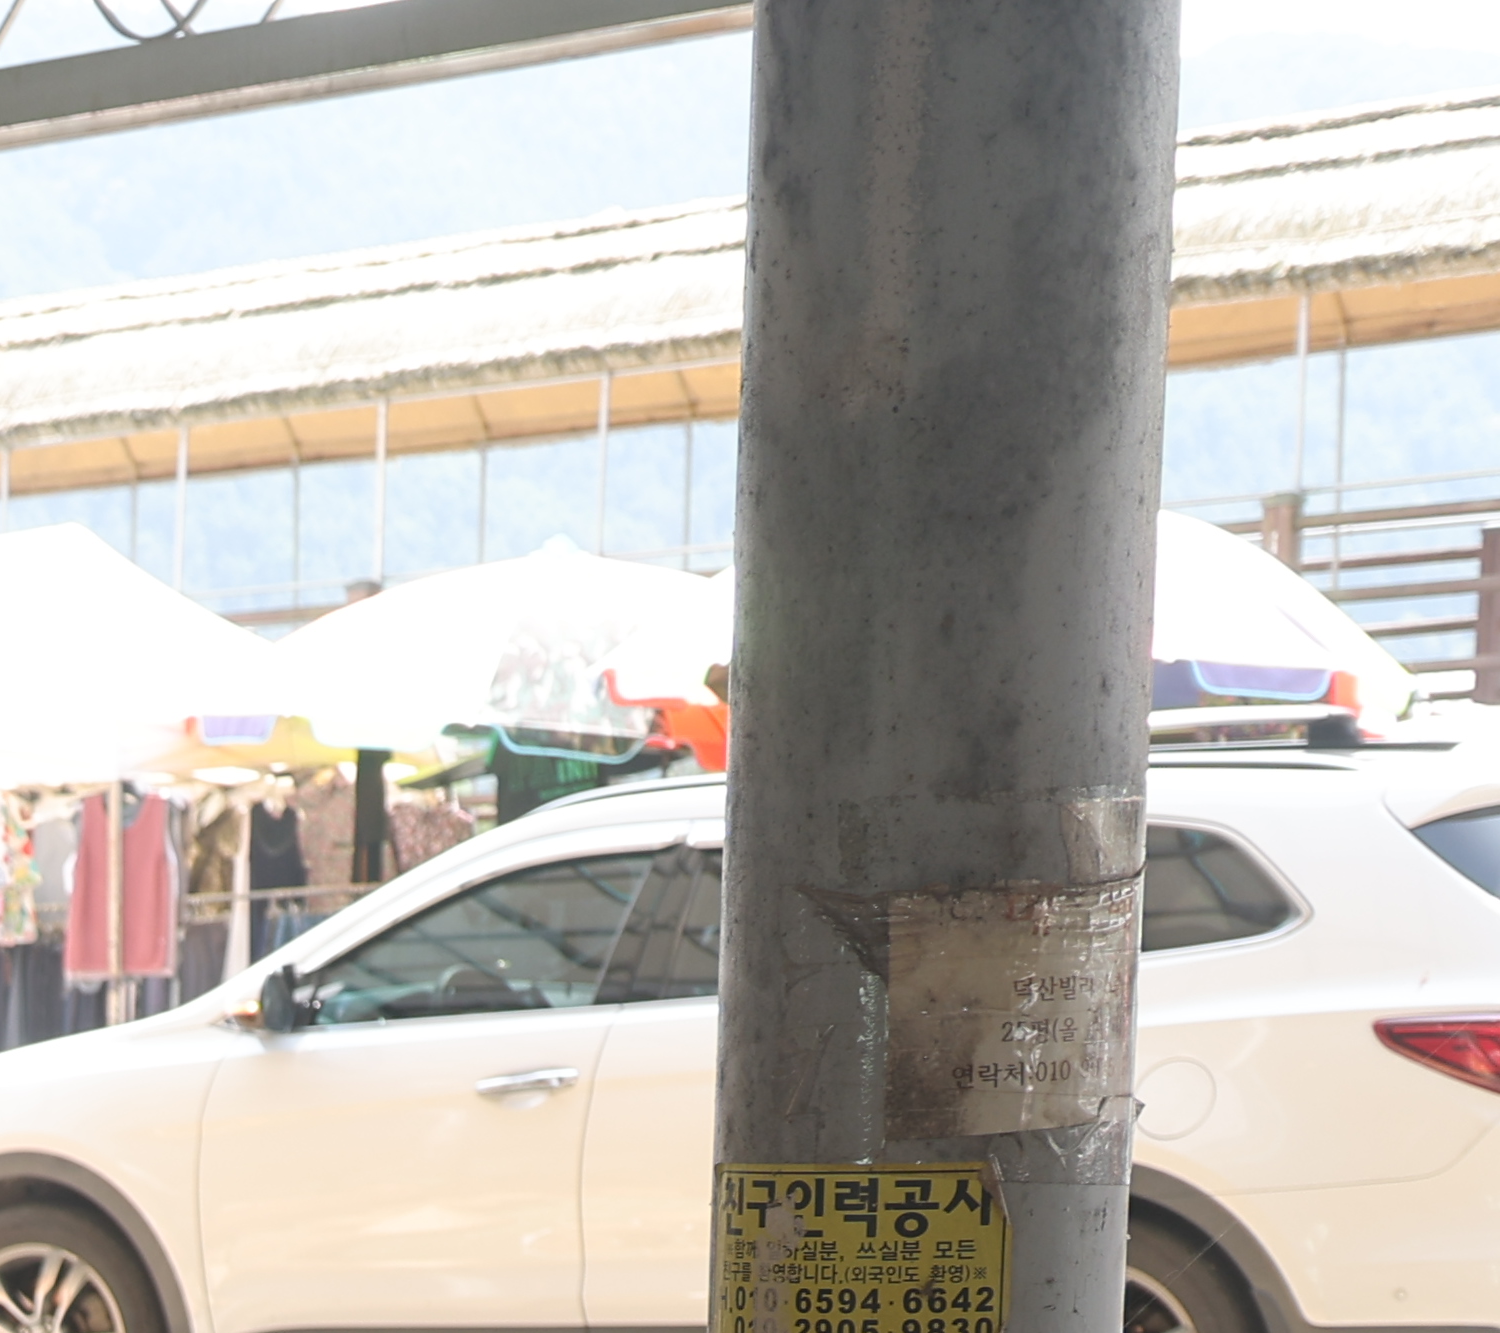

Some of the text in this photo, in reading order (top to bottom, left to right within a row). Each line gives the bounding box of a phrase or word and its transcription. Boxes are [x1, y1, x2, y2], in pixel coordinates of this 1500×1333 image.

[723, 1176, 995, 1239] 친구인력공사
[856, 1241, 922, 1260] 쓰실분
[932, 1239, 977, 1260] 모든
